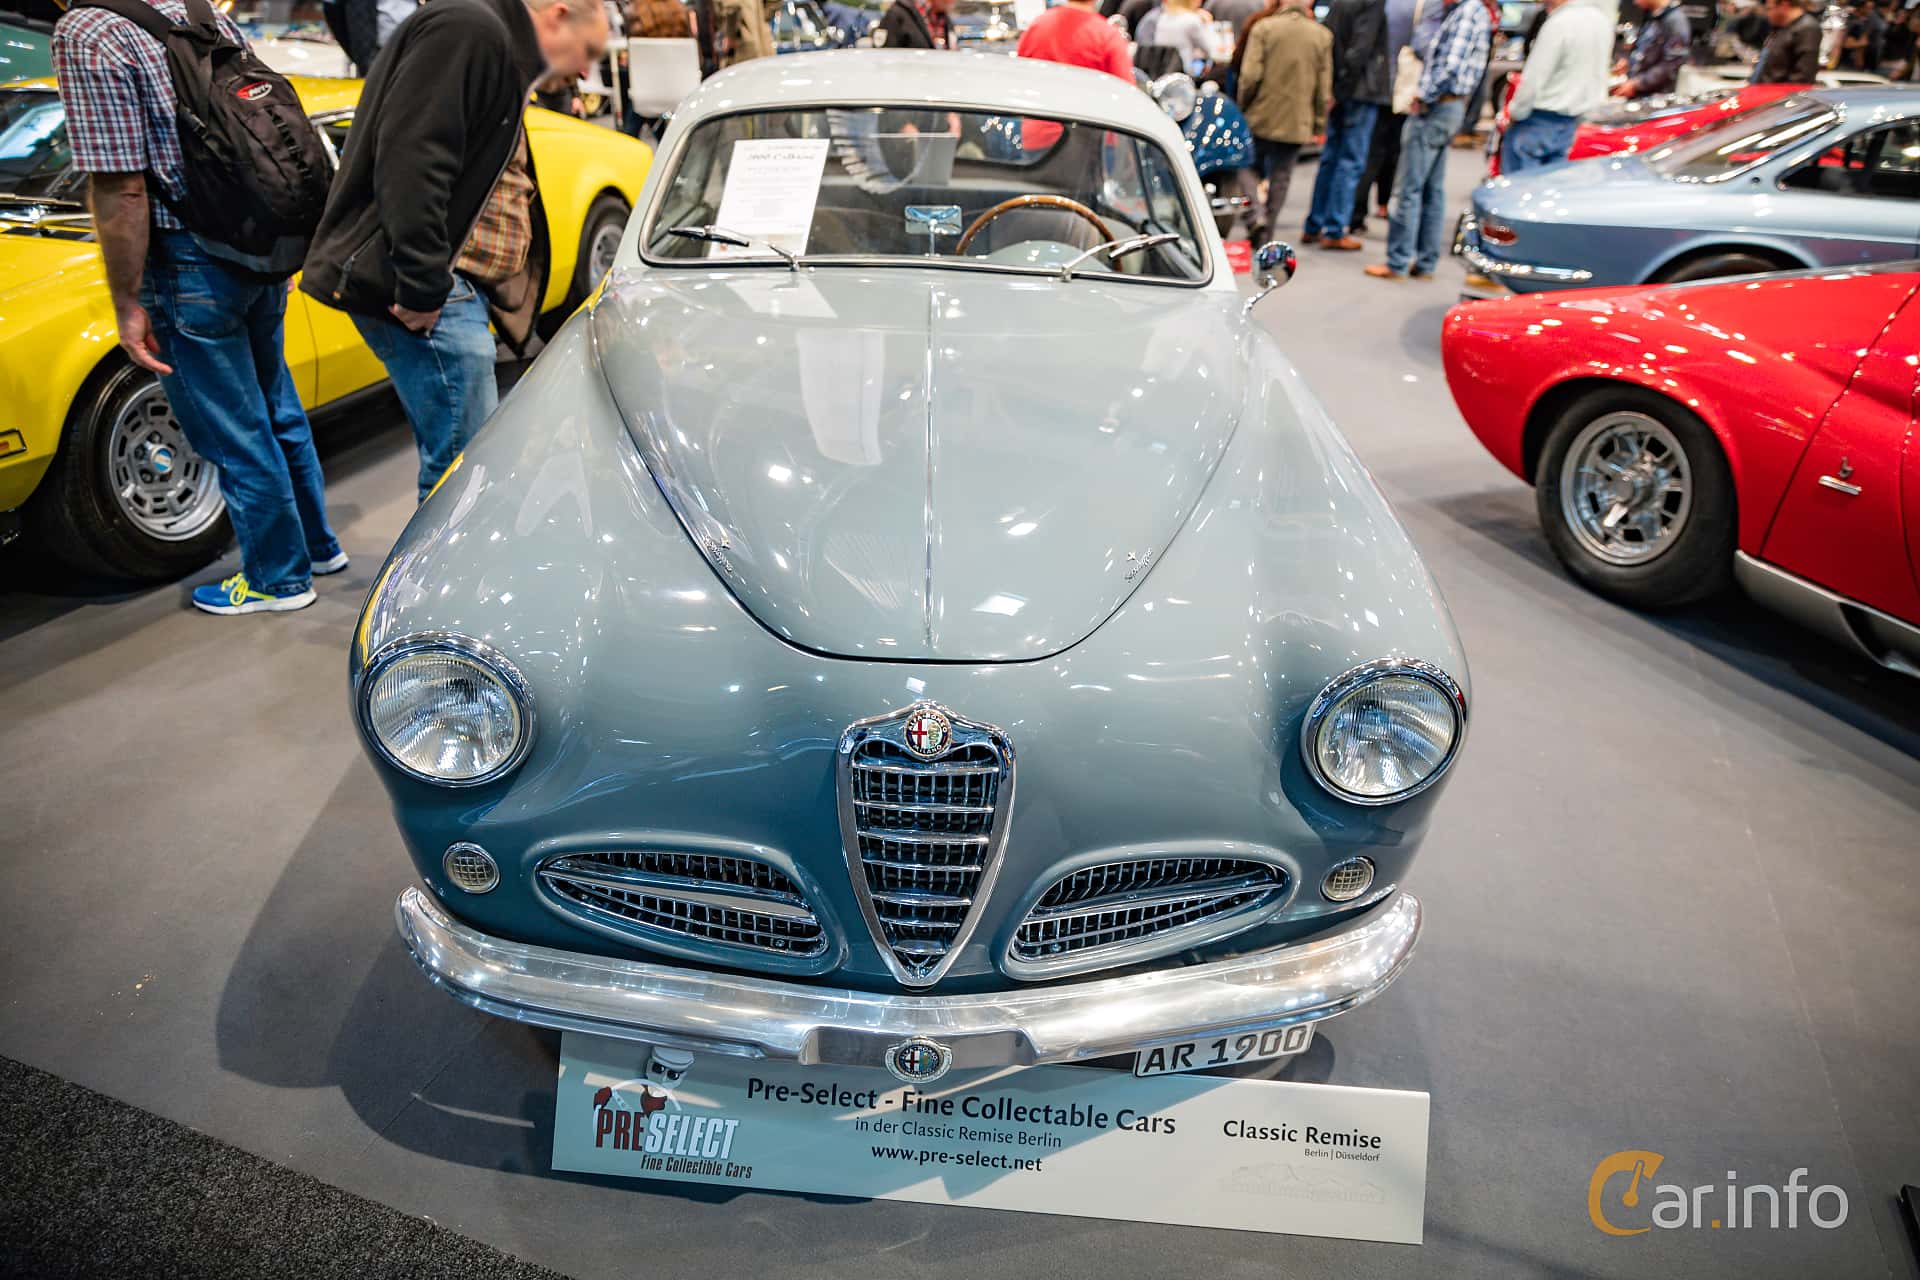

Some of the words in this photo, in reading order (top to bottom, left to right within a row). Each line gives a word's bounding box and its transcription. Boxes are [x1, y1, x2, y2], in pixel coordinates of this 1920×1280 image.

[1143, 1043, 1196, 1073] AR
[1207, 1025, 1308, 1065] 1900
[747, 1078, 878, 1109] Pre-Select
[902, 1091, 954, 1116] Fine
[961, 1096, 1108, 1129] Collectable
[1116, 1109, 1176, 1134] Cars
[855, 1117, 869, 1132] in
[873, 1118, 899, 1133] der
[902, 1121, 954, 1139] Classic
[959, 1127, 1013, 1144] Remise
[1018, 1131, 1062, 1148] Berlin
[1223, 1120, 1298, 1142] Classic
[1305, 1126, 1382, 1149] Remise
[641, 1154, 663, 1171] Fine
[666, 1156, 723, 1177] Collectible
[725, 1162, 753, 1179] Cars
[872, 1146, 1042, 1172] www.pre-select.net
[1304, 1149, 1329, 1158] Berlin
[1335, 1150, 1380, 1162] Düsseldorf
